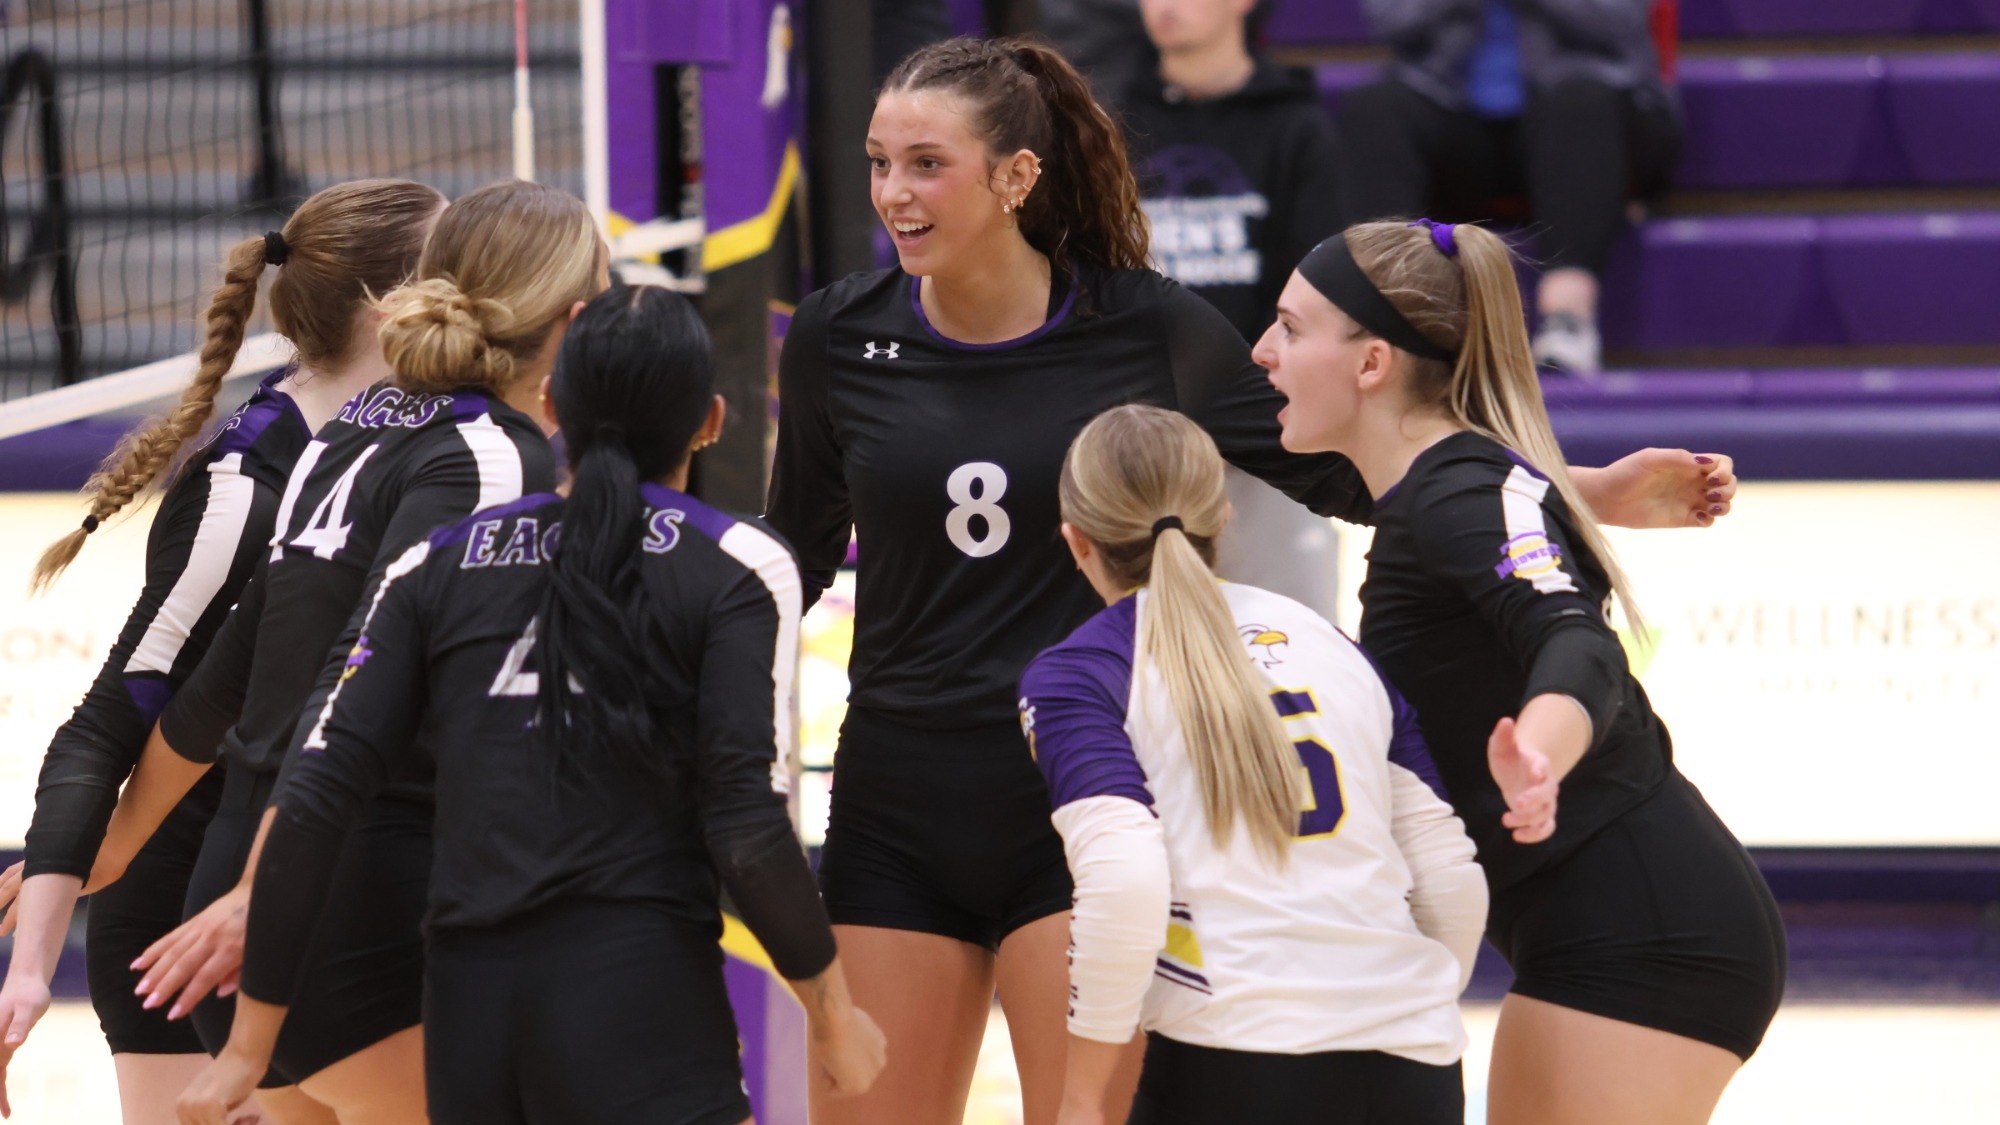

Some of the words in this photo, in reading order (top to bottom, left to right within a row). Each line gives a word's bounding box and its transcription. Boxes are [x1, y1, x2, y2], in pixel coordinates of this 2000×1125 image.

[269, 440, 380, 564] 14
[460, 508, 686, 569] EAS
[945, 461, 1011, 558] 8
[1687, 600, 1999, 648] WELLNESS
